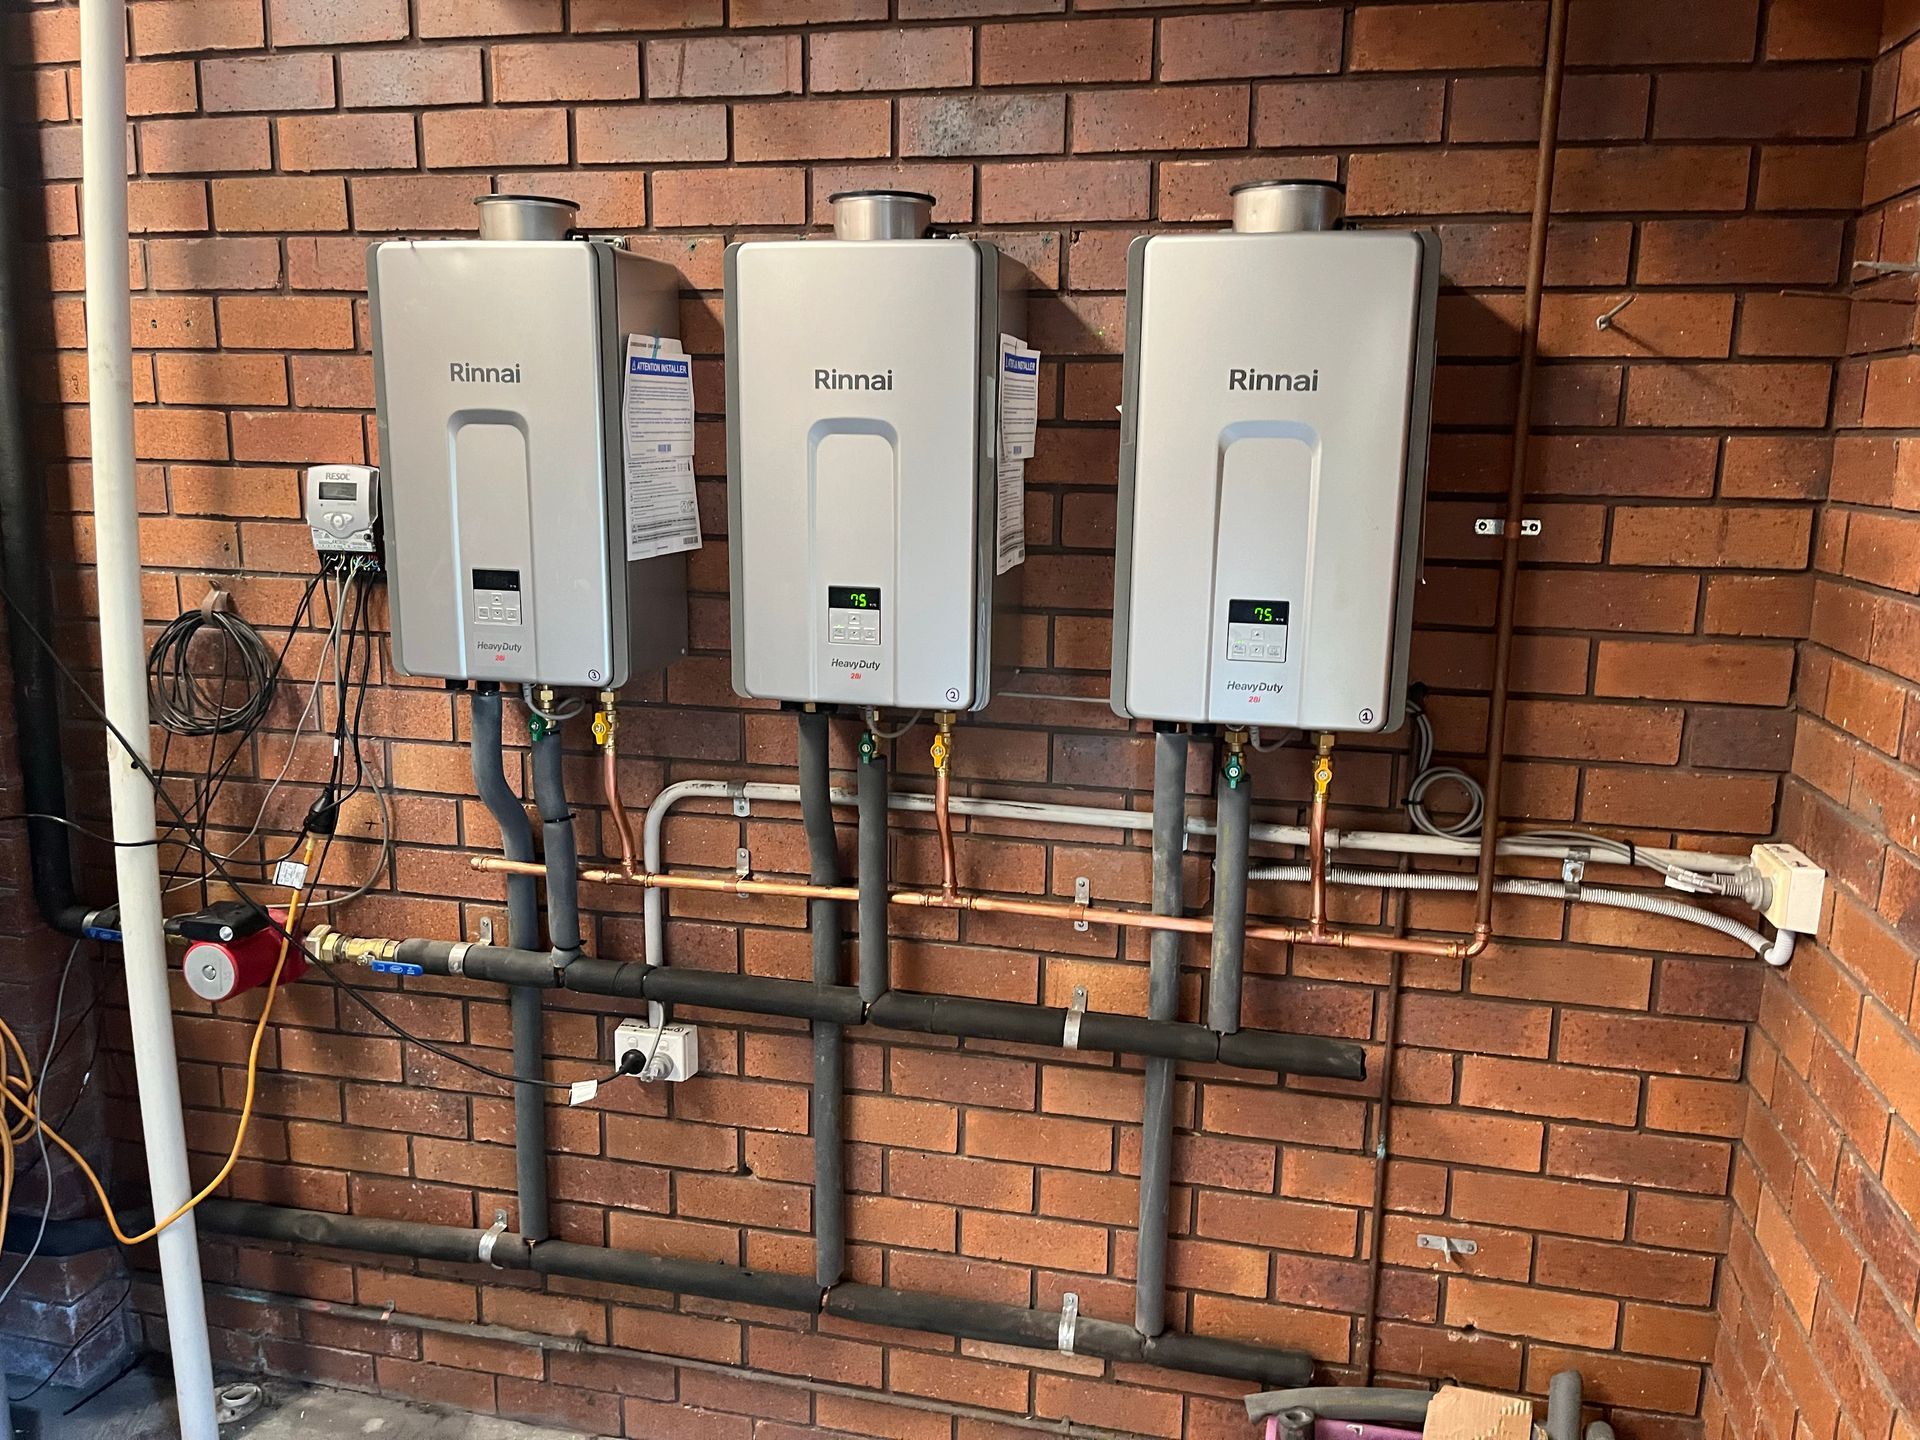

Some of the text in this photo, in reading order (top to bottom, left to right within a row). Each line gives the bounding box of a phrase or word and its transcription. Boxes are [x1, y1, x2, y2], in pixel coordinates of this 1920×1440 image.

[450, 362, 521, 383] Rinnai
[637, 361, 687, 374] ATTENTION INSTALLER
[814, 368, 893, 390] Rinnai
[1229, 368, 1319, 391] Rinnai
[850, 593, 867, 607] 75
[1254, 607, 1273, 622] 75
